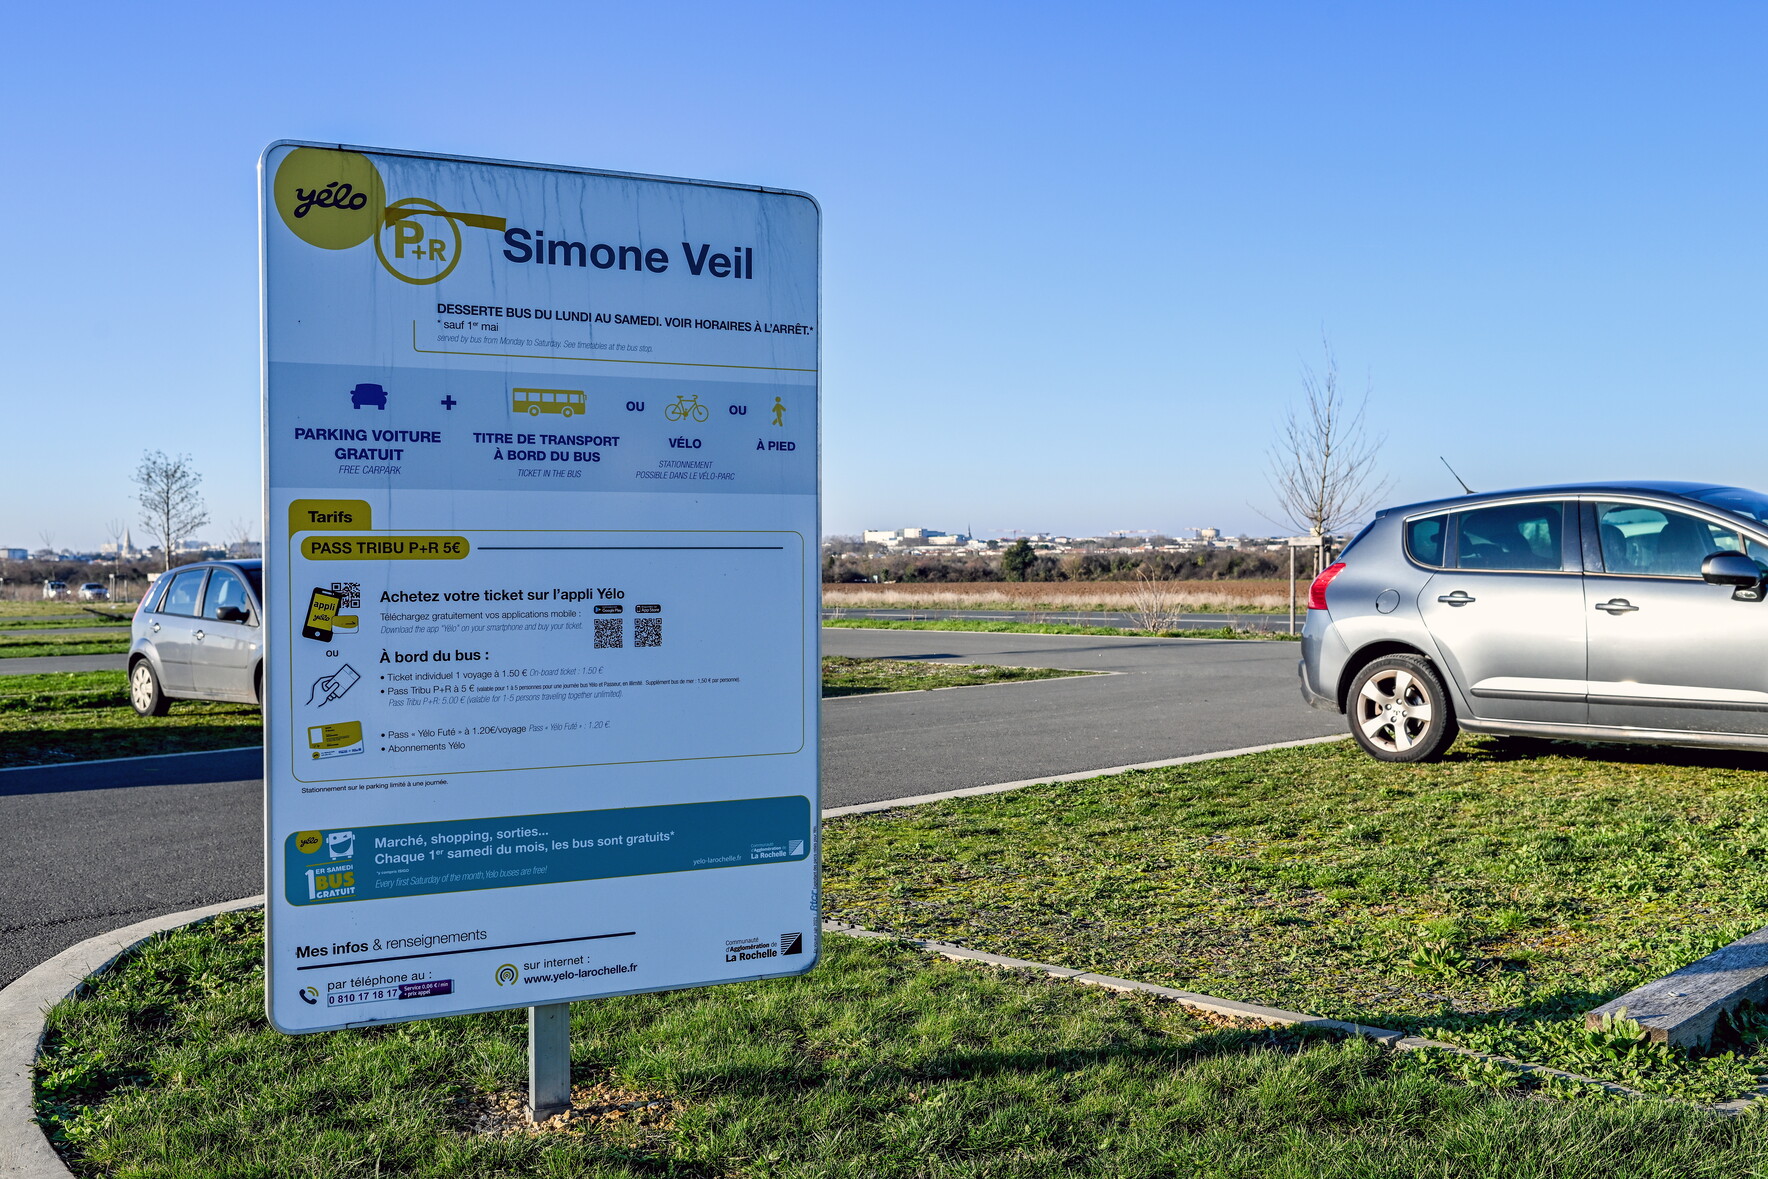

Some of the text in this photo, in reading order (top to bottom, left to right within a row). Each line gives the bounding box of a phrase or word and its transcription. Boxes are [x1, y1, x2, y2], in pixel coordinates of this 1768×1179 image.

[293, 181, 368, 219] yélo
[394, 219, 447, 263] P+R
[503, 227, 753, 280] Simone Veil
[437, 303, 503, 317] DESSERTE
[506, 307, 531, 319] BUS
[534, 308, 552, 320] DU
[555, 310, 591, 322] LUNDI
[594, 312, 611, 323] AU
[614, 313, 662, 326] SAMEDI.
[664, 316, 692, 328] VOIR
[694, 318, 751, 332] HORAIRES
[753, 320, 762, 332] À
[443, 320, 498, 331] sauf 1er mai
[436, 333, 459, 343] served
[460, 334, 469, 344] by
[469, 334, 482, 343] bus
[483, 335, 498, 344] from
[499, 336, 525, 347] Monday
[525, 338, 533, 346] to
[533, 337, 561, 350] Saturday.
[563, 339, 576, 348] See
[577, 339, 607, 350] timetables
[615, 343, 625, 351] the
[626, 343, 638, 351] bus
[638, 344, 653, 353] stop.
[626, 401, 645, 412] OU
[729, 404, 747, 416] OU
[294, 427, 441, 443] PARKING VOITURE
[472, 432, 620, 446] TITRE DE TRANSPORT
[668, 436, 702, 449] VÉLO
[756, 437, 795, 451] À PIED
[334, 447, 405, 461] GRATUIT
[493, 446, 600, 462] À BORD DU BUS
[338, 464, 401, 476] FREE CARPARK
[658, 460, 713, 470] STATIONNEMENT
[518, 468, 582, 478] TICKET IN THE BUS
[635, 470, 735, 480] POSSIBLE DANS LE VÉLO-PARC
[307, 510, 353, 523] Tarifs
[311, 541, 460, 554] PASS TRIBU P+R 5€
[379, 587, 624, 602] Achetez votre ticket sur l'appli Yélo
[313, 600, 336, 612] appli
[379, 612, 429, 622] Téléchargez
[431, 611, 483, 622] gratuitement
[501, 610, 549, 620] applications
[550, 609, 576, 617] mobile
[379, 648, 481, 663] À bord du bus
[386, 672, 412, 681] Ticket
[414, 671, 453, 680] individuel
[462, 671, 492, 680] voyage
[493, 669, 499, 678] à
[502, 668, 520, 677] 1.50
[521, 668, 527, 677] €
[529, 669, 558, 677] On-board
[559, 668, 577, 676] ticket
[582, 667, 597, 675] 1.50
[387, 684, 474, 695] Pass Tribu P+R à 5 €
[388, 725, 526, 739] Pass Yélo Futé à 1.20€/voyage
[387, 740, 465, 753] Abonnements Yélo
[301, 785, 346, 793] Stationnement
[365, 782, 388, 790] parking
[424, 778, 448, 787] journée.
[374, 827, 548, 848] Marché, shopping, sorties...
[374, 852, 424, 864] Chaque
[429, 849, 443, 860] 1er
[447, 844, 492, 858] samedi
[496, 843, 511, 855] du
[515, 841, 547, 853] mois,
[551, 839, 569, 850] les
[572, 838, 593, 848] bus
[597, 835, 623, 846] sont
[693, 855, 742, 866] yelo-larochelle.fr
[326, 864, 354, 873] SAMEDI
[315, 871, 355, 891] BUS
[316, 887, 356, 899] GRATUIT
[295, 929, 487, 958] Mes infos & renseignements
[725, 937, 759, 946] Communauté
[725, 942, 770, 953] d'Agglomération
[523, 955, 583, 970] sur internet
[725, 949, 777, 963] La Rochelle
[524, 962, 638, 984] www.yelo-larochelle.fr
[327, 972, 424, 992] par téléphone au
[328, 988, 399, 1006] 0 810 17 18 17
